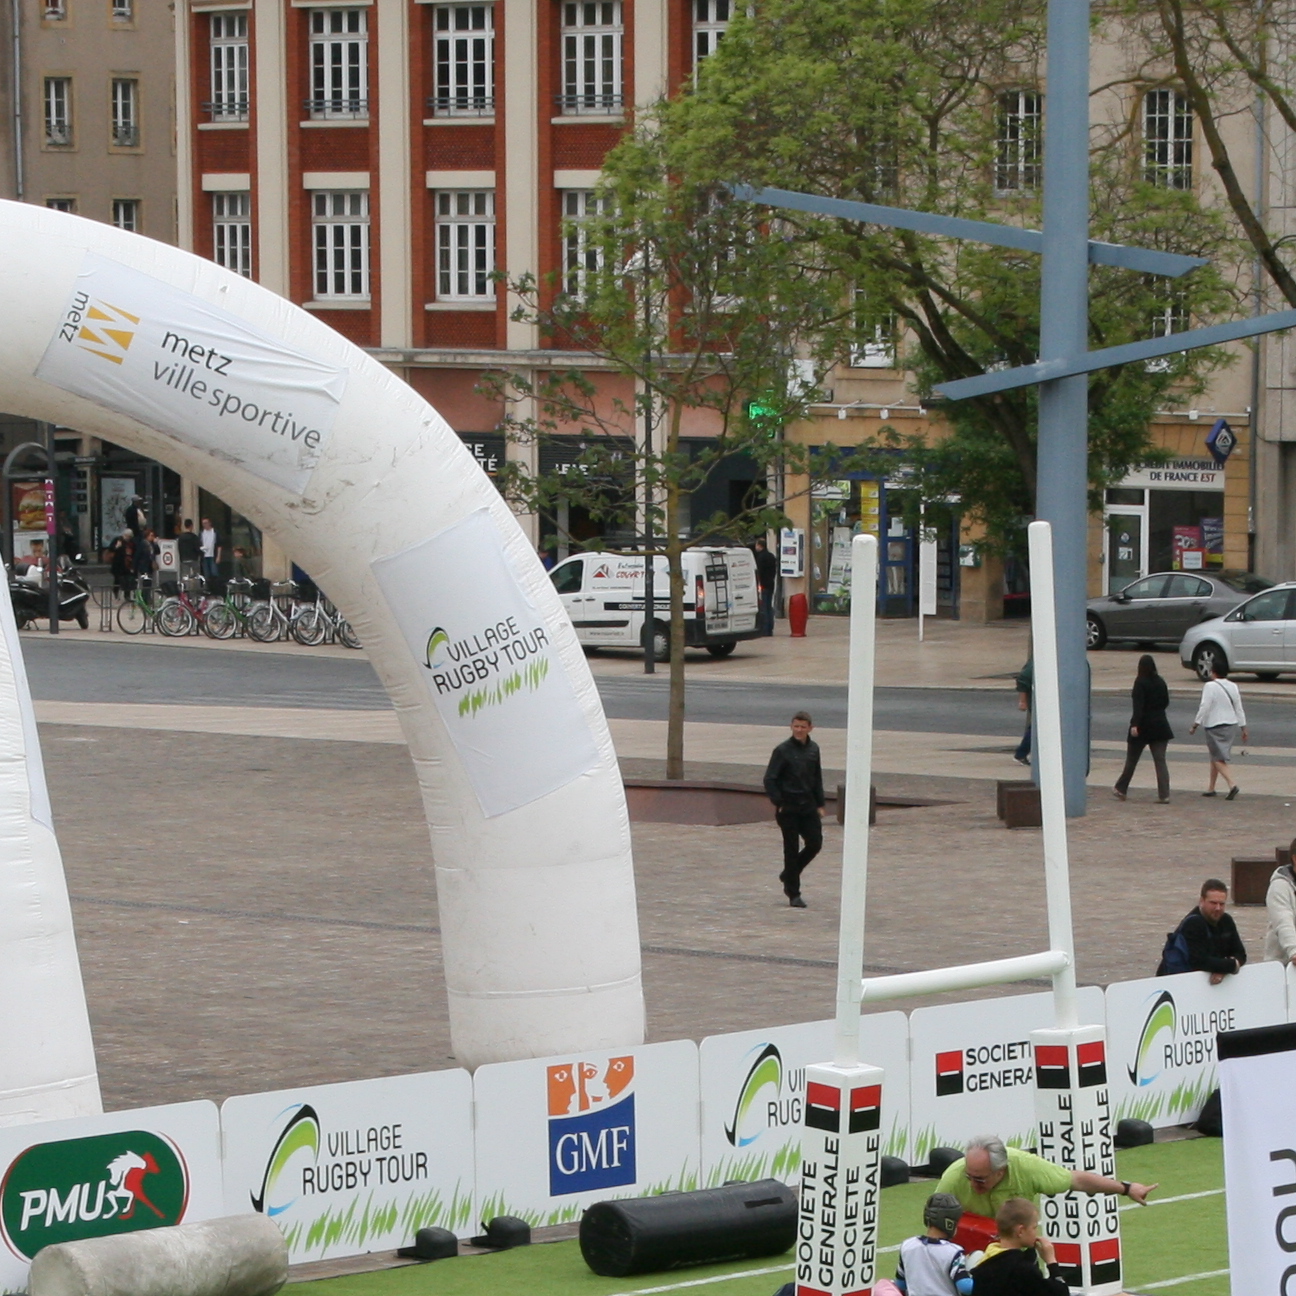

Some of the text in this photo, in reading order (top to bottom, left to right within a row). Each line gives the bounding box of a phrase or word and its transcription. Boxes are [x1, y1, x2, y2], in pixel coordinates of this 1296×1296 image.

[59, 291, 90, 343] metz
[161, 331, 232, 377] metz
[1150, 471, 1216, 482] DE FRANCE EST
[432, 627, 550, 695] RUGBY TOUR
[446, 616, 520, 662] VILLAGE
[1181, 1008, 1236, 1037] VILLAGE
[966, 1040, 1031, 1066] SOCIET
[1164, 1040, 1213, 1069] RUGBY
[966, 1067, 1033, 1092] GENERA
[767, 1097, 804, 1128] RUG
[327, 1124, 402, 1158] VILLAGE
[556, 1126, 630, 1176] GMF
[303, 1152, 428, 1196] RUGBY TOUR
[19, 1180, 104, 1232] PMU
[798, 1159, 817, 1283] SOCIETE
[818, 1136, 840, 1287] GENERALE
[841, 1165, 860, 1288] SOCIETE
[860, 1134, 880, 1284] GENERALE
